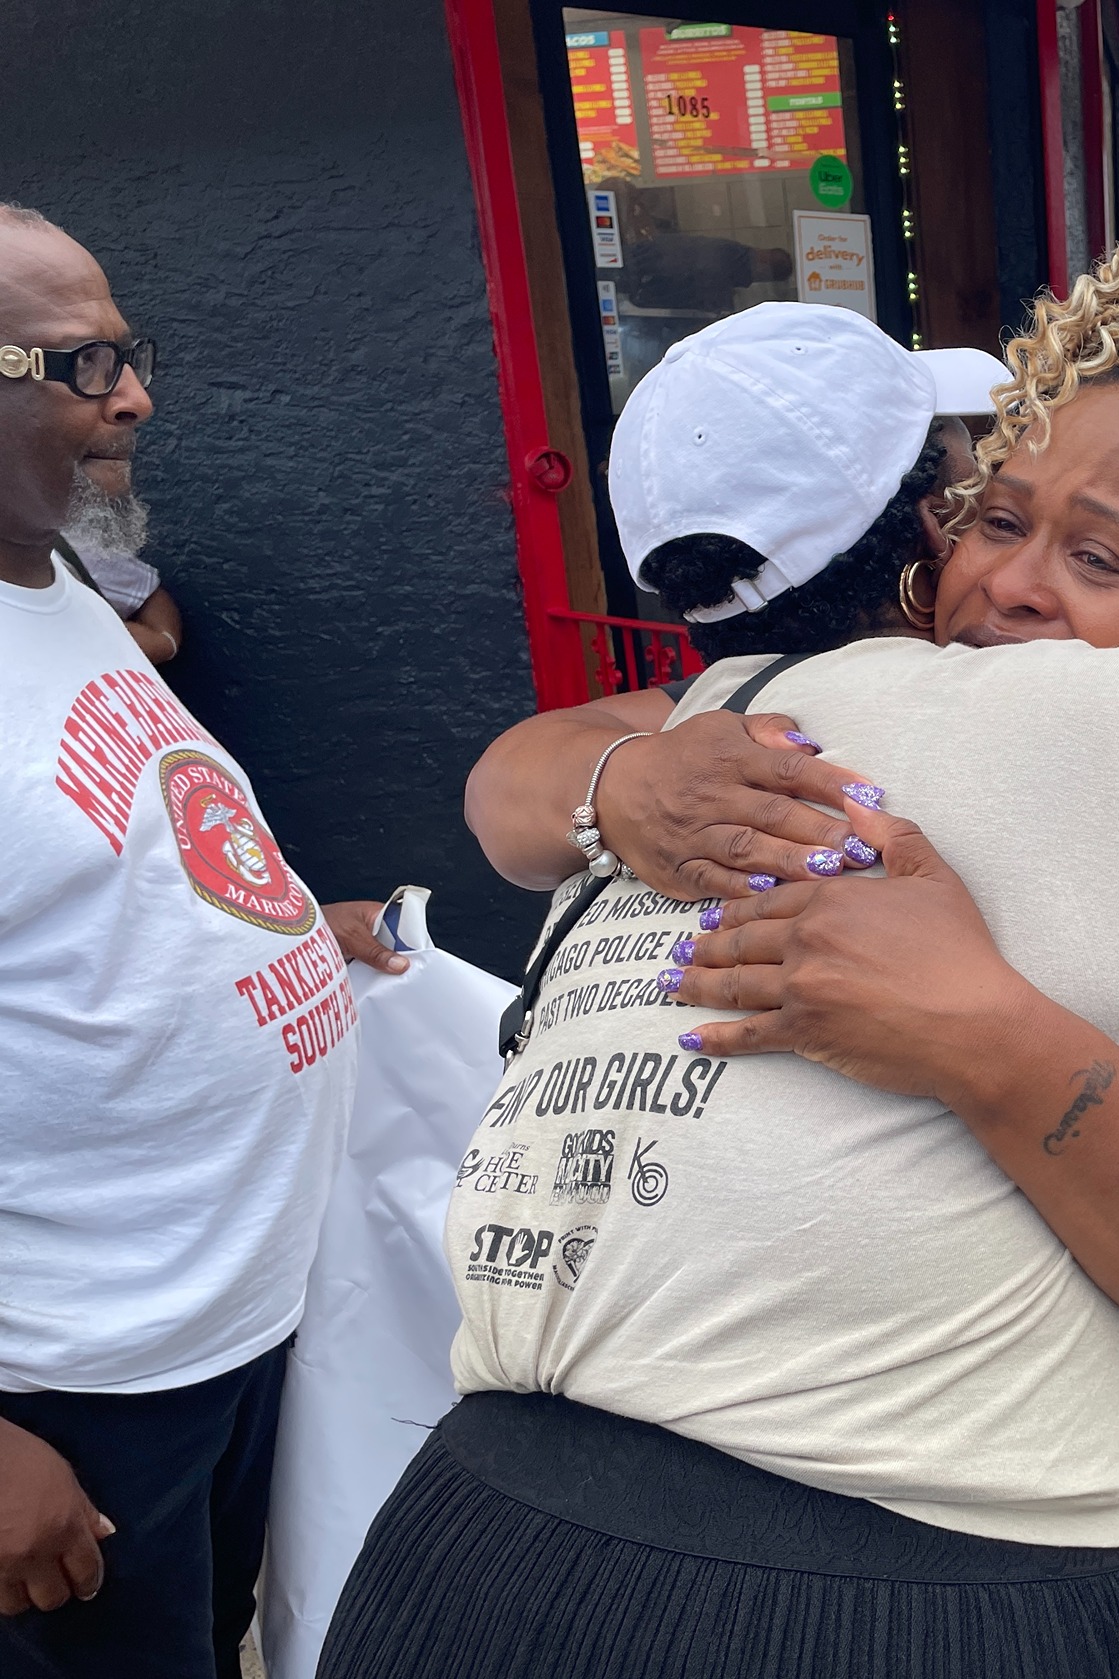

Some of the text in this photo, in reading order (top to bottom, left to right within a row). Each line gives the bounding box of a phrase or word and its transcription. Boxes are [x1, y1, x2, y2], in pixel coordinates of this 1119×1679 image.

[666, 94, 711, 119] 1085
[805, 245, 865, 267] delivery
[56, 680, 153, 857] MARINE
[169, 766, 248, 850] UNITED STATE
[225, 884, 299, 918] MARINE
[588, 930, 672, 968] POLICE
[234, 935, 334, 1028] TANKIES
[281, 990, 344, 1075] SOUTH
[535, 993, 564, 1038] PAST
[563, 983, 600, 1023] TWO
[535, 1056, 598, 1118] OUR
[593, 1051, 728, 1120] GIRLS!
[469, 1223, 555, 1270] STOP
